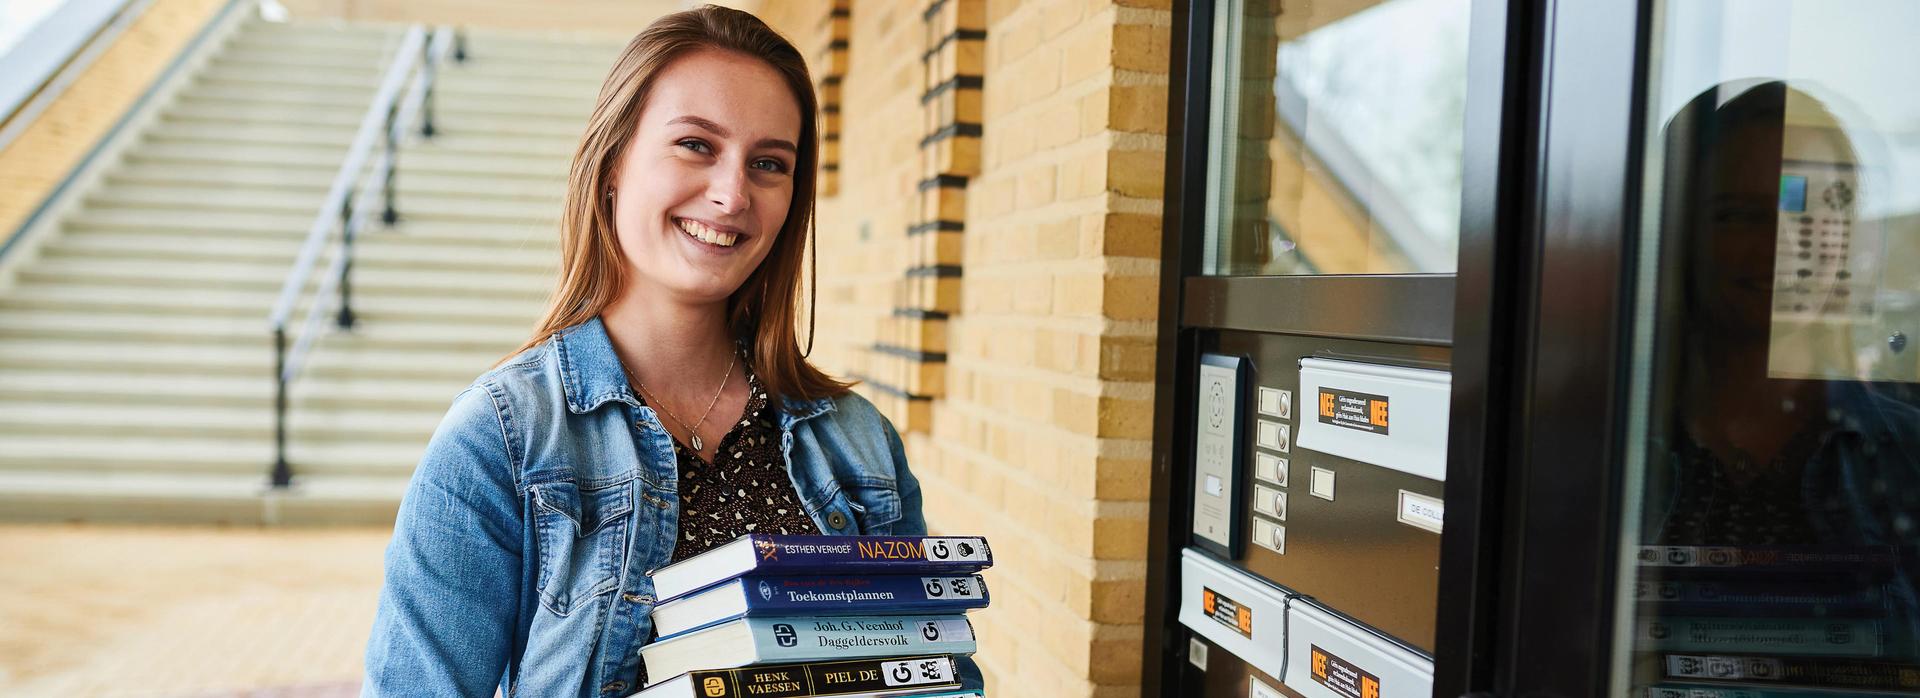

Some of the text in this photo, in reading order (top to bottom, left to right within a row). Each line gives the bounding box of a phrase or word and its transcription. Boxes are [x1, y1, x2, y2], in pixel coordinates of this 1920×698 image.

[785, 545, 816, 554] ESTHER
[817, 545, 851, 554] VERHOEF
[787, 590, 894, 603] Toekomstplannen
[814, 620, 904, 632] Joh. G. Veenhof
[818, 635, 908, 649] Daggeldersvolk
[754, 672, 790, 683] HENK
[825, 670, 878, 684] PIEL DE
[748, 681, 800, 694] VAESSEN
